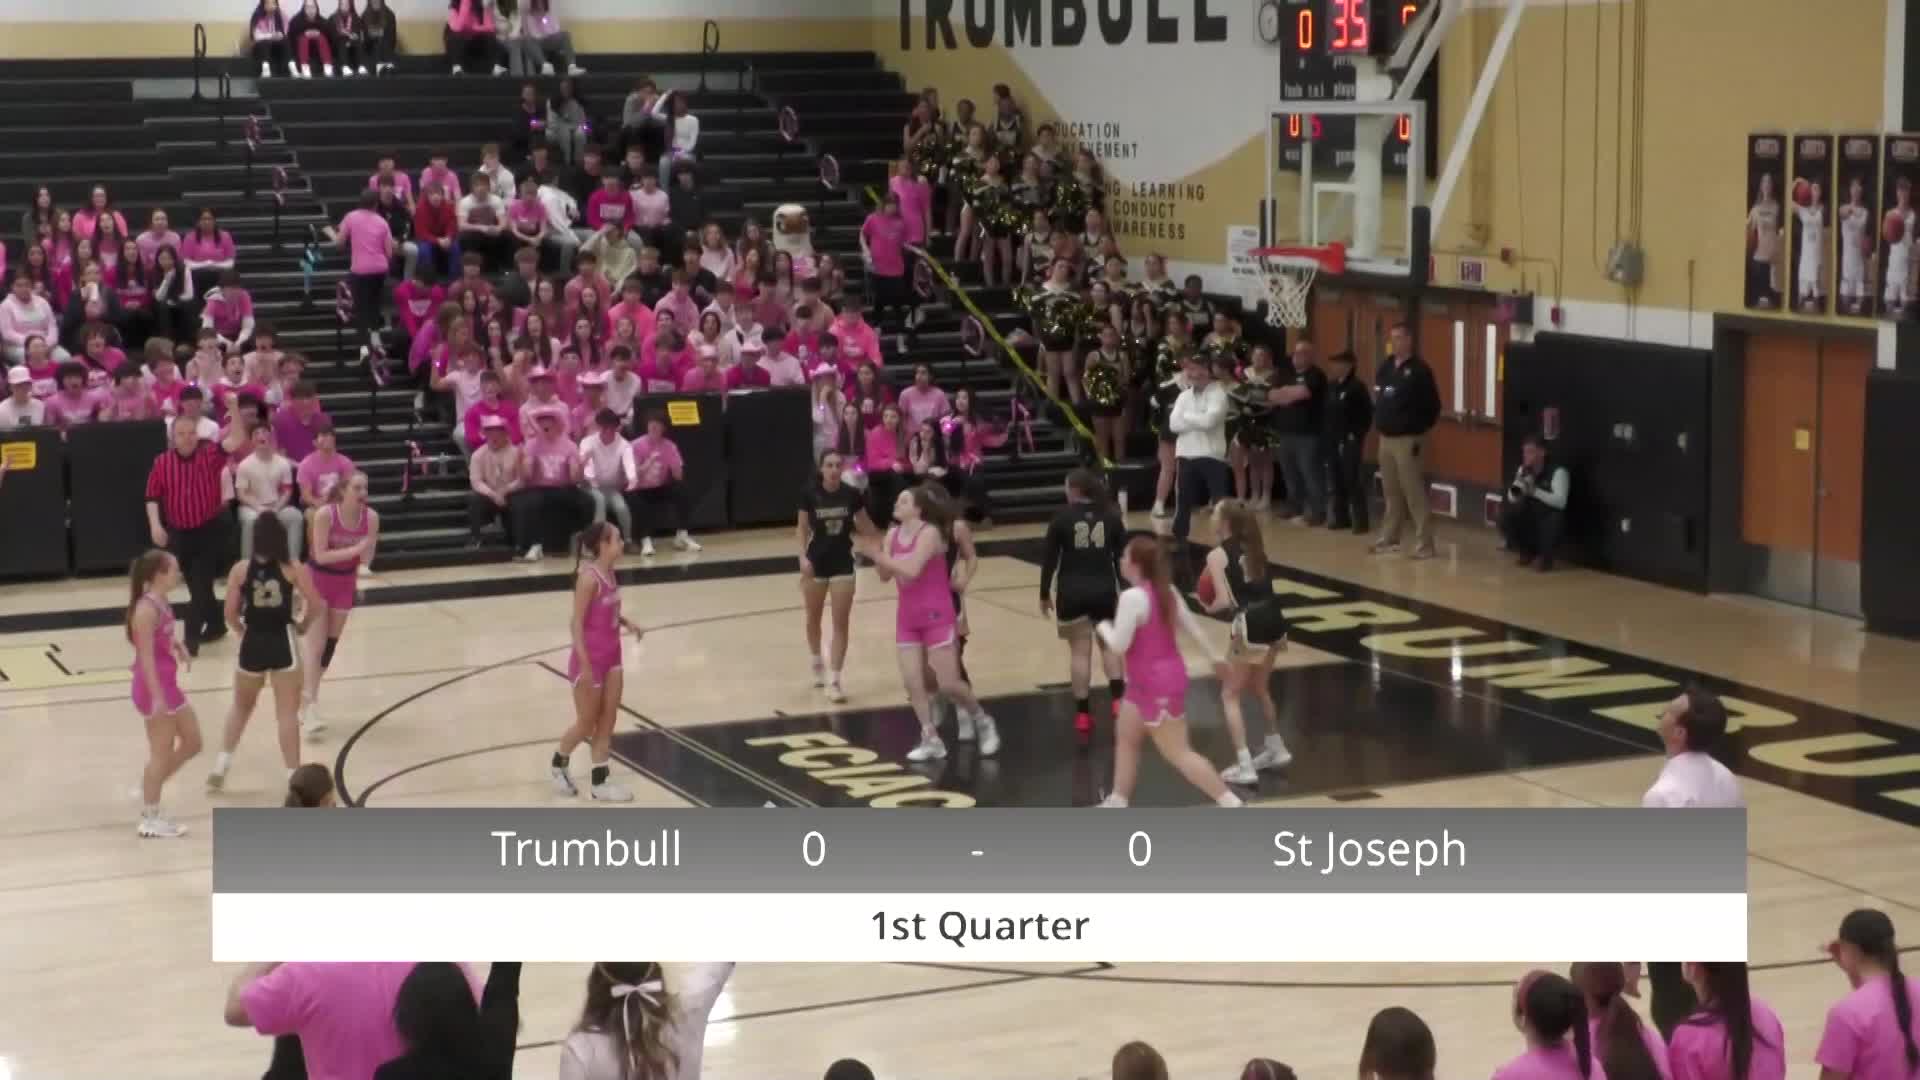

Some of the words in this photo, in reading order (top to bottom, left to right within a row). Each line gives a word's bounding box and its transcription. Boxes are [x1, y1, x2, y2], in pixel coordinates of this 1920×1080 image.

[1299, 9, 1313, 49] 0
[1331, 0, 1368, 49] 35
[1054, 121, 1121, 139] DUCATION
[1131, 181, 1206, 202] LEARNING
[1112, 200, 1176, 219] CONDUCT
[1109, 219, 1186, 241] WARENESS
[1074, 520, 1105, 549] 24
[744, 731, 977, 808] FCIAC
